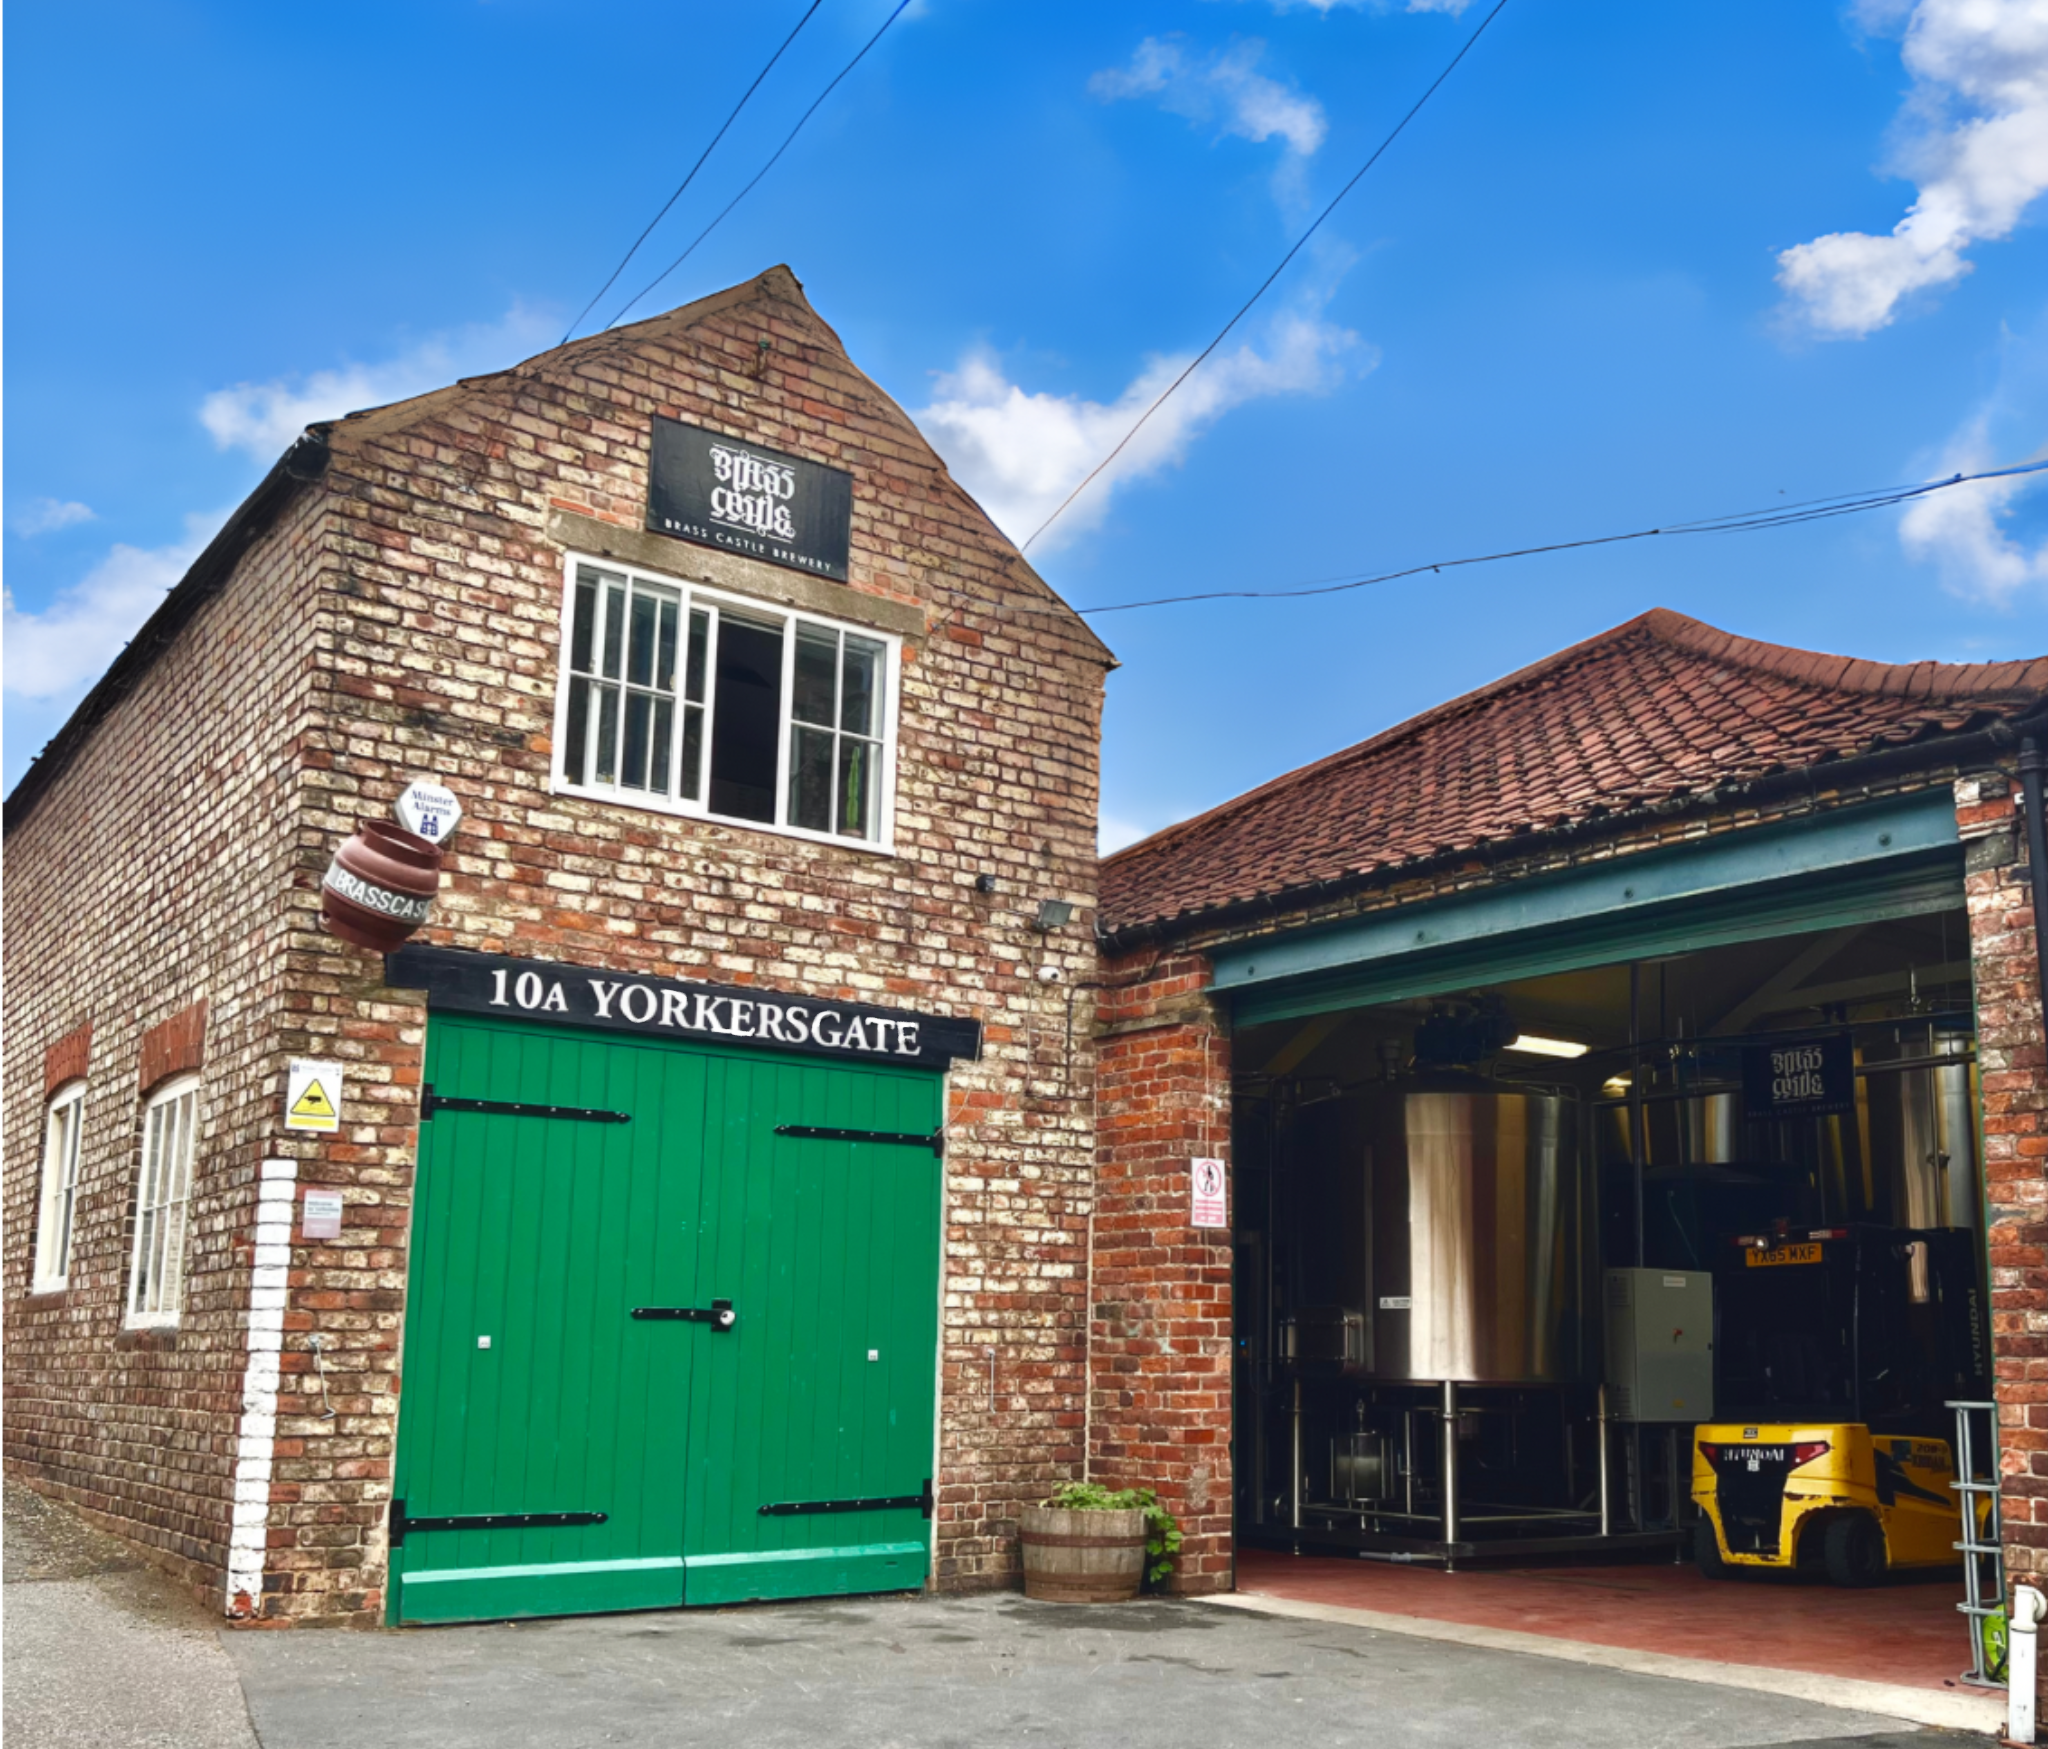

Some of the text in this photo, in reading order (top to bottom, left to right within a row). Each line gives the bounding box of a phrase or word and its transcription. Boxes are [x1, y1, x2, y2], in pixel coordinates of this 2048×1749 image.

[665, 518, 832, 572] BRASS CASTLE BREWERY
[411, 789, 455, 807] Minster
[412, 801, 452, 816] Alarms
[588, 978, 922, 1056] YORKERSGATE
[1752, 1245, 1816, 1263] YX65 MXF
[1966, 1288, 1984, 1377] HYUNDAI
